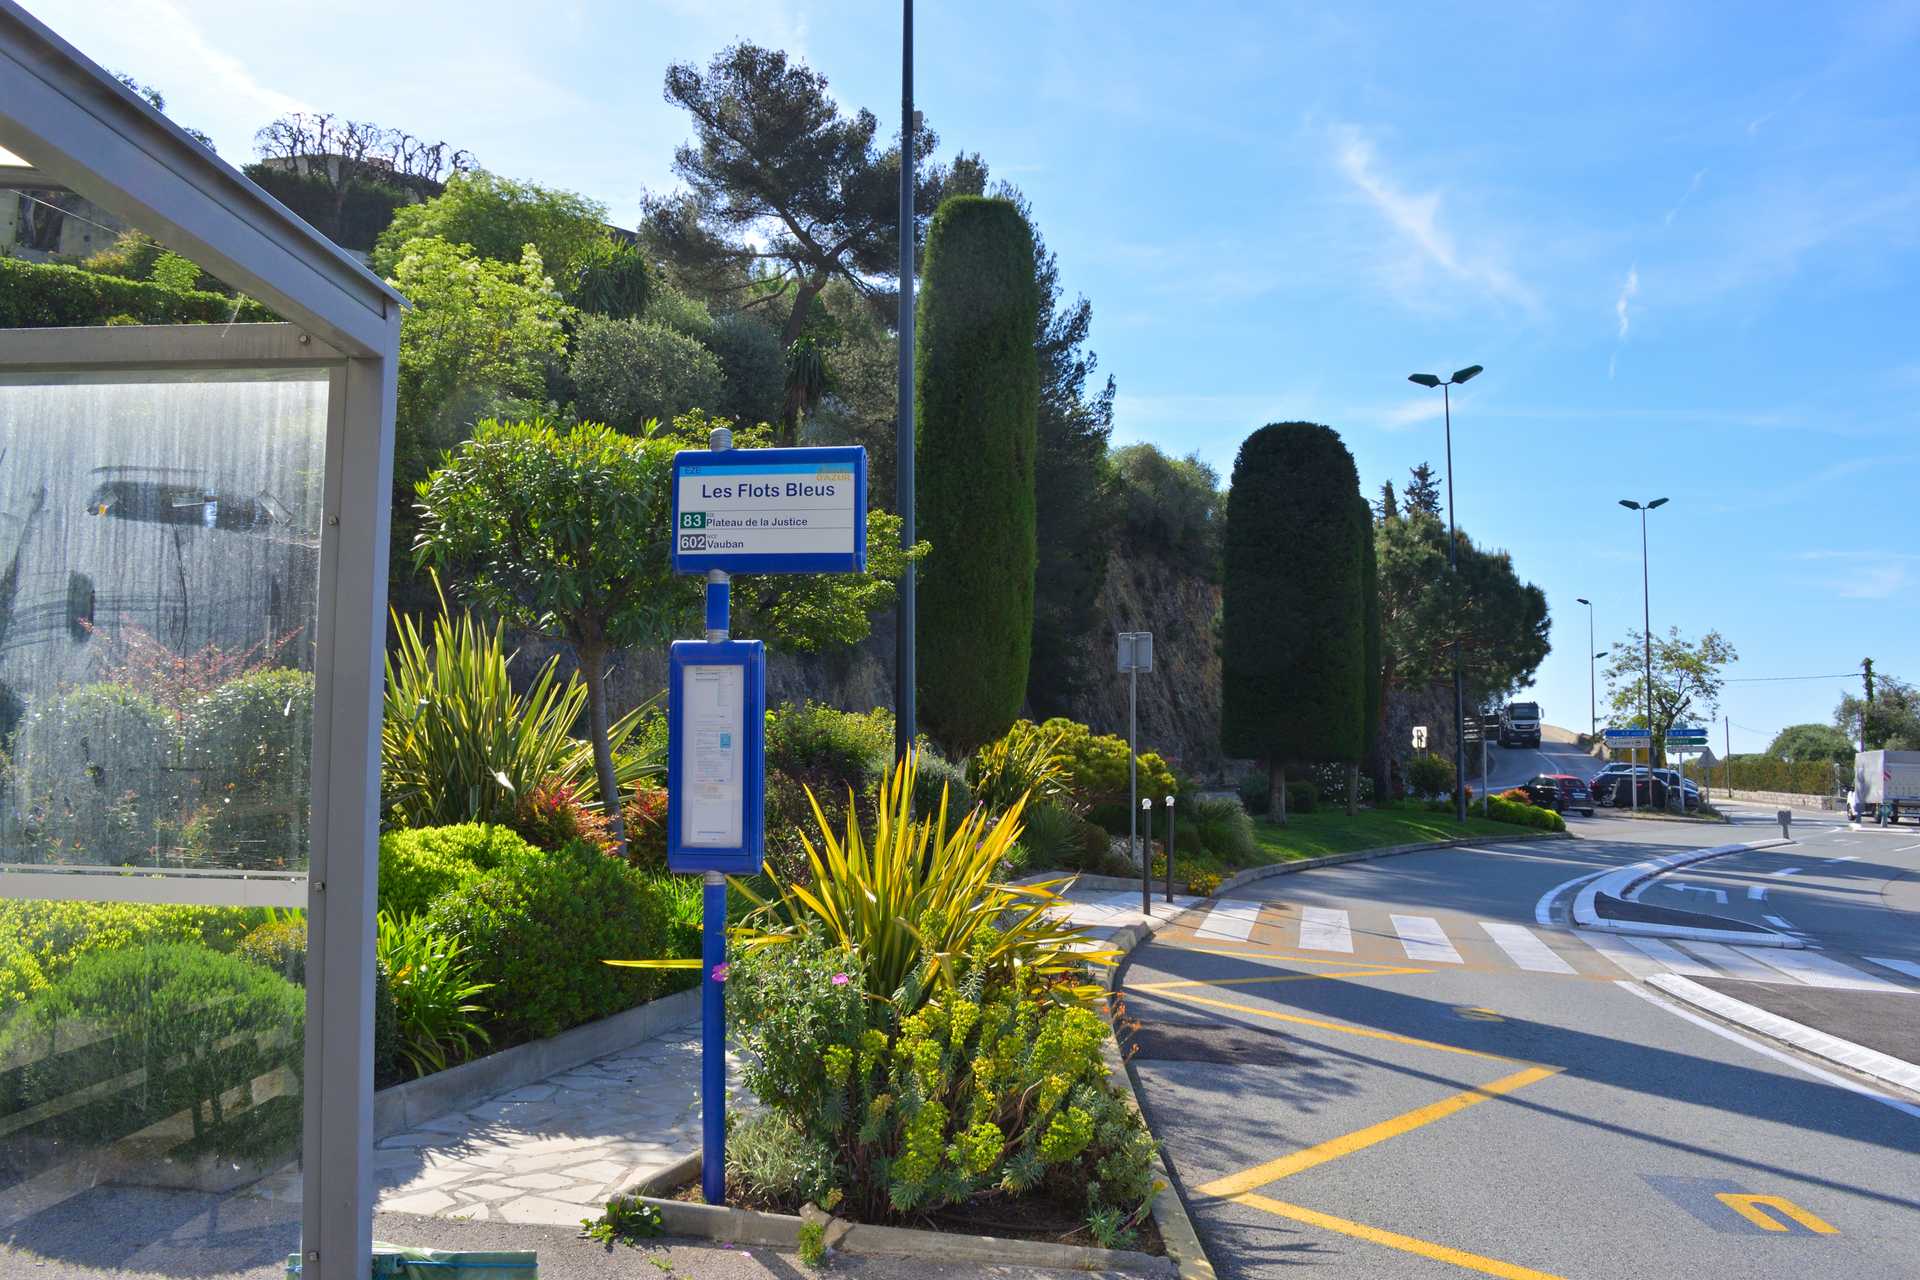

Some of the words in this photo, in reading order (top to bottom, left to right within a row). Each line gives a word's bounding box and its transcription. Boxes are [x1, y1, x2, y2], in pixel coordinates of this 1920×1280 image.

[702, 484, 732, 498] Les
[738, 483, 780, 498] Flots
[786, 482, 835, 497] Bleus
[683, 514, 702, 527] 83
[706, 518, 743, 527] Plateau
[745, 517, 759, 527] de
[760, 517, 769, 527] la
[771, 517, 808, 527] Justice
[681, 536, 706, 549] 602
[707, 539, 744, 549] Vauban
